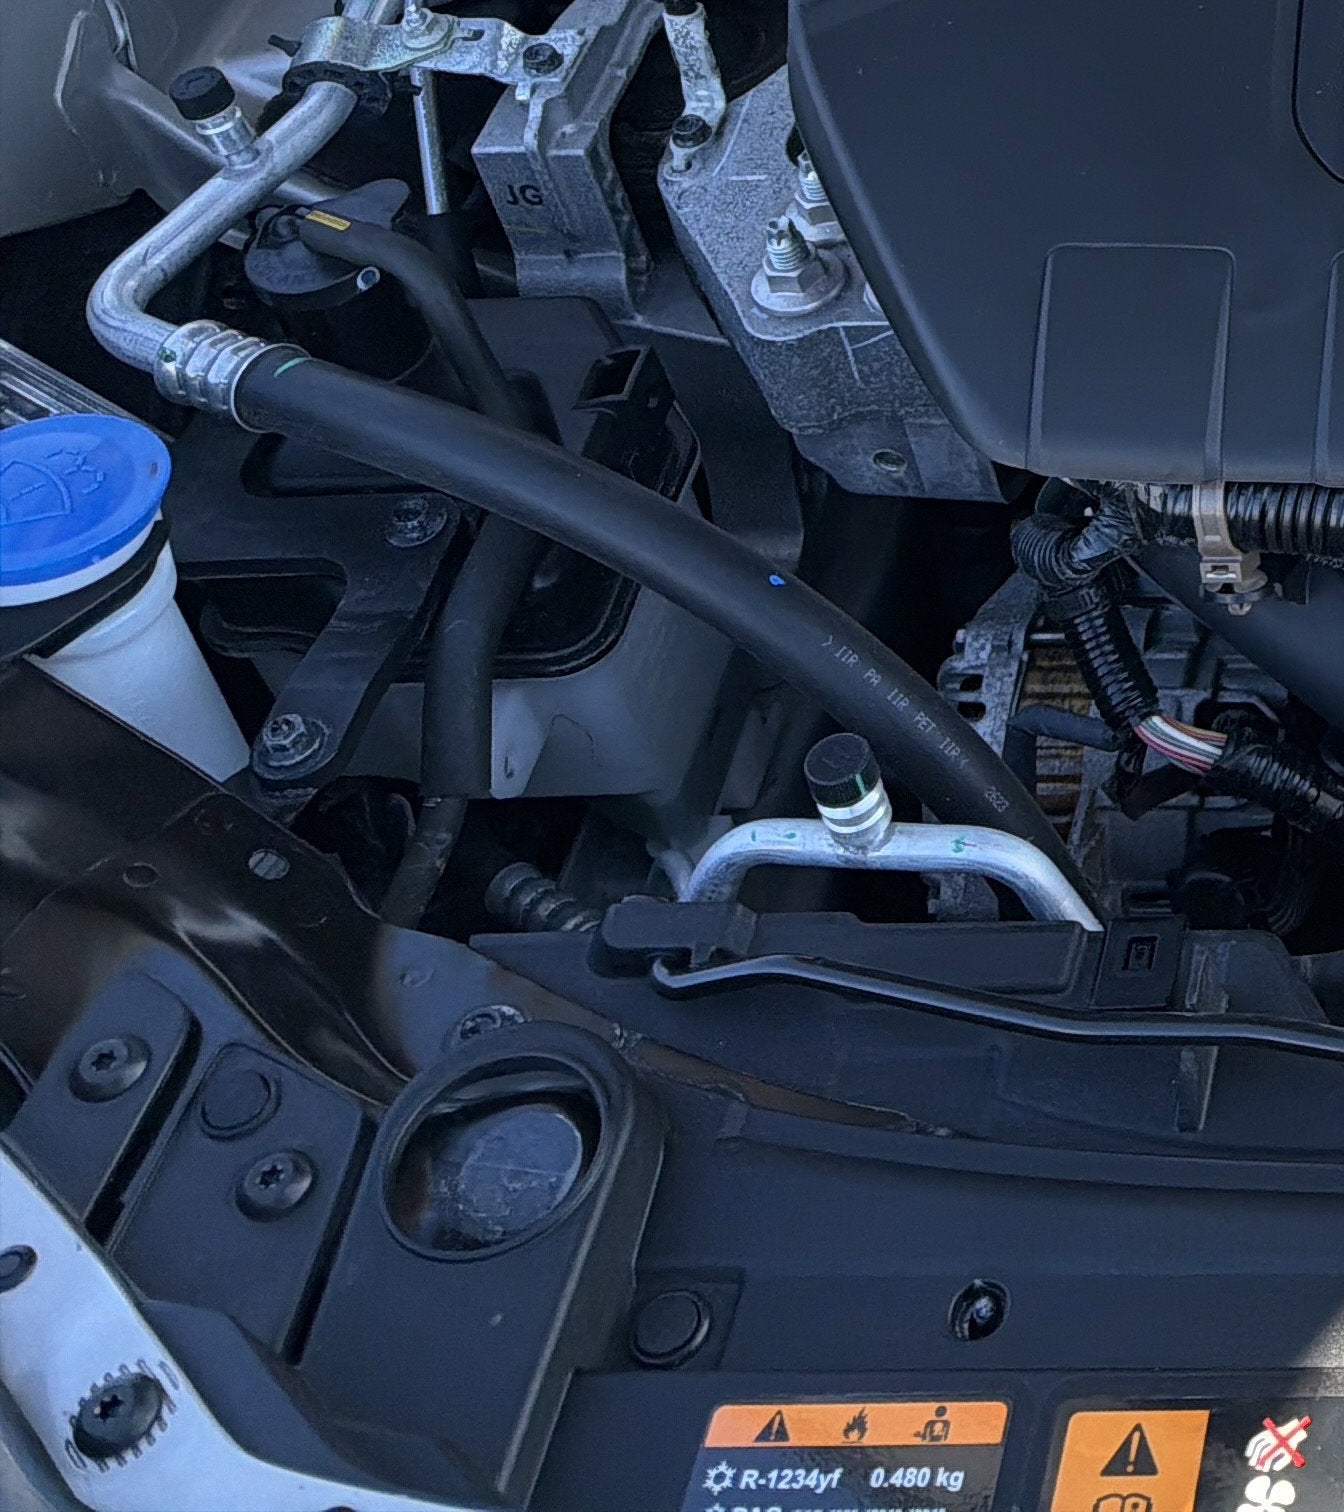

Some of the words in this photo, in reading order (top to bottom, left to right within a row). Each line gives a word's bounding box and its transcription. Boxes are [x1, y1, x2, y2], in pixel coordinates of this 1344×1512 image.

[506, 184, 544, 206] JG
[740, 1467, 844, 1493] R-1234yf
[870, 1466, 931, 1488] 0.480
[936, 1466, 965, 1492] kg
